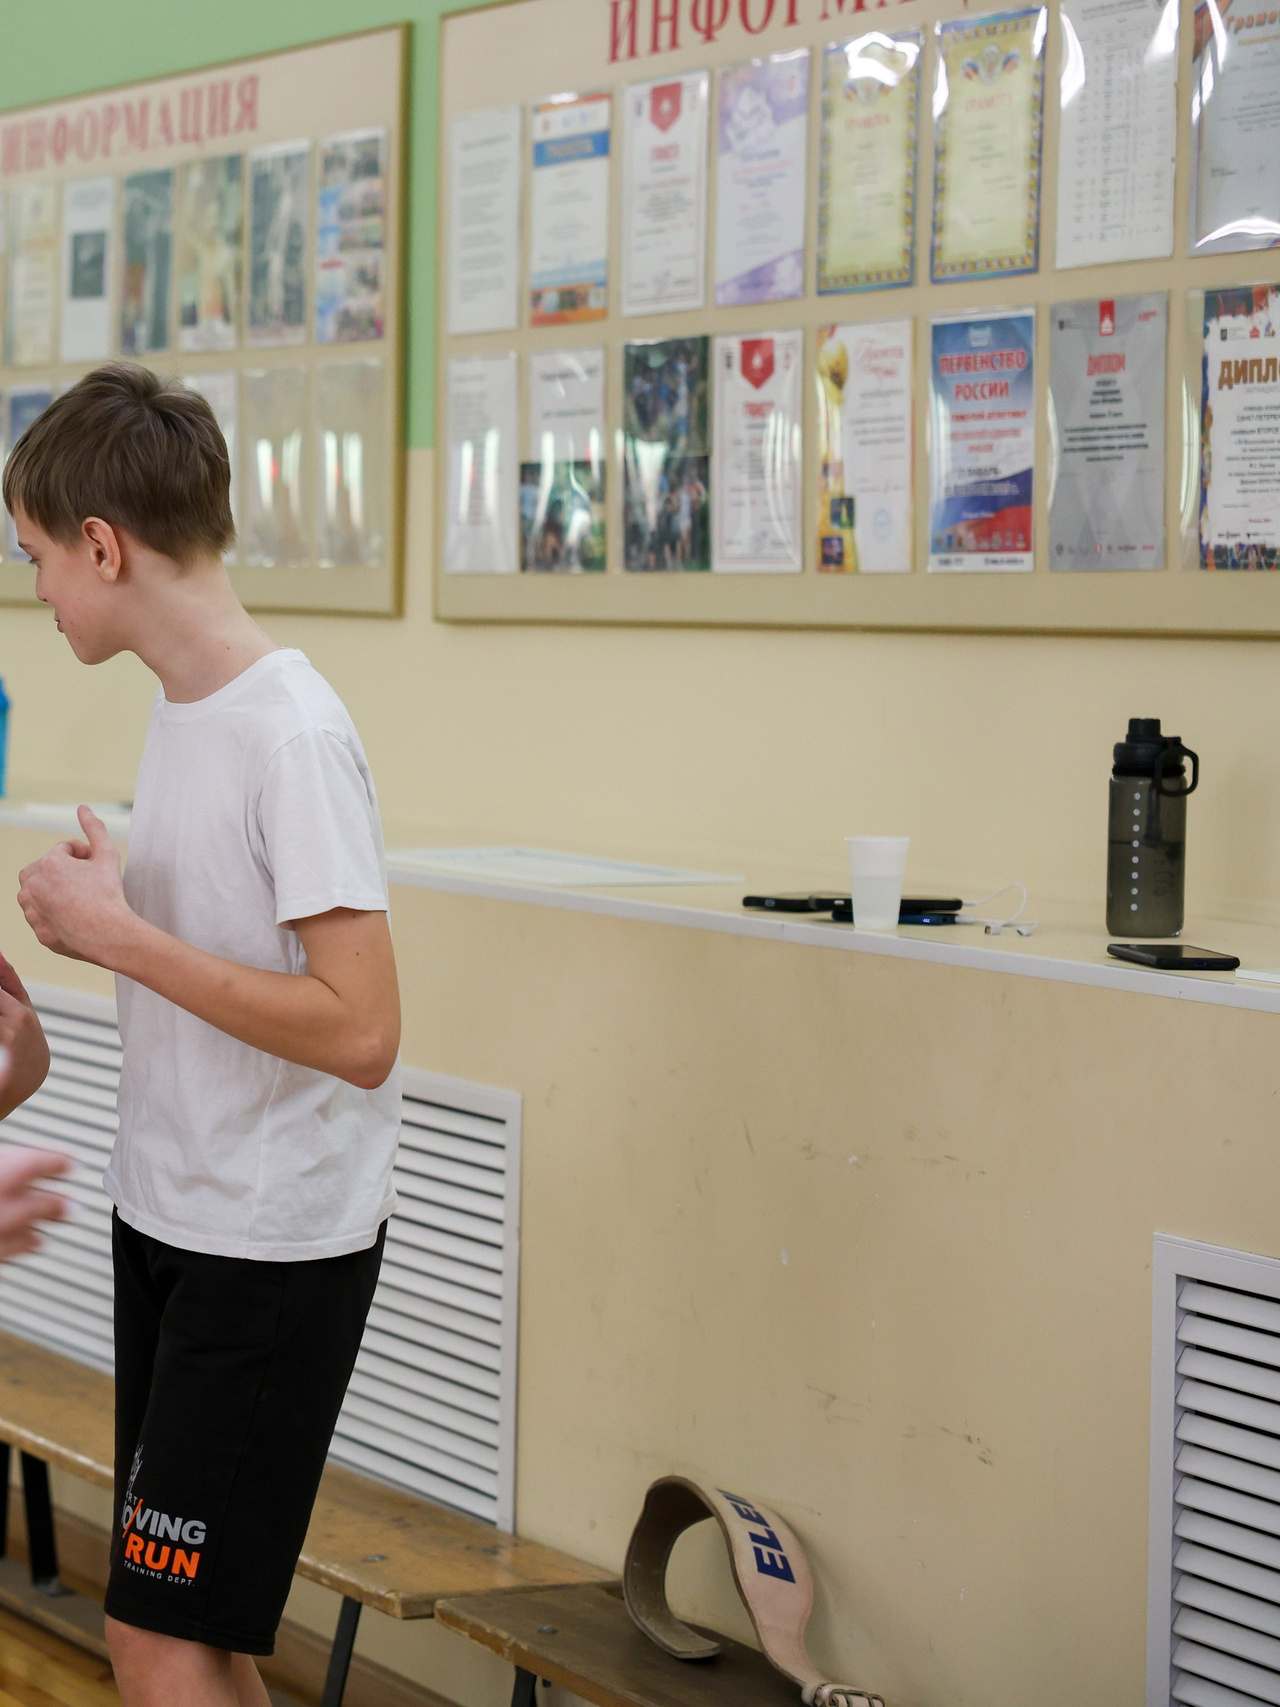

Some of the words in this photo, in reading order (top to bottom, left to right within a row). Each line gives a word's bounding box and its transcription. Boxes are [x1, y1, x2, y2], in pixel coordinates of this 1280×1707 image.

[1226, 8, 1280, 34] Грамо
[1, 74, 260, 176] ИНФОРМАЦИЯ
[938, 348, 1026, 375] ПЕРВЕНСТВО
[1217, 357, 1280, 391] ДИПЛ
[953, 381, 1010, 401] РОССИИ
[121, 1500, 207, 1545] OVING
[123, 1559, 163, 1580] TRAINING
[125, 1532, 201, 1579] RUN
